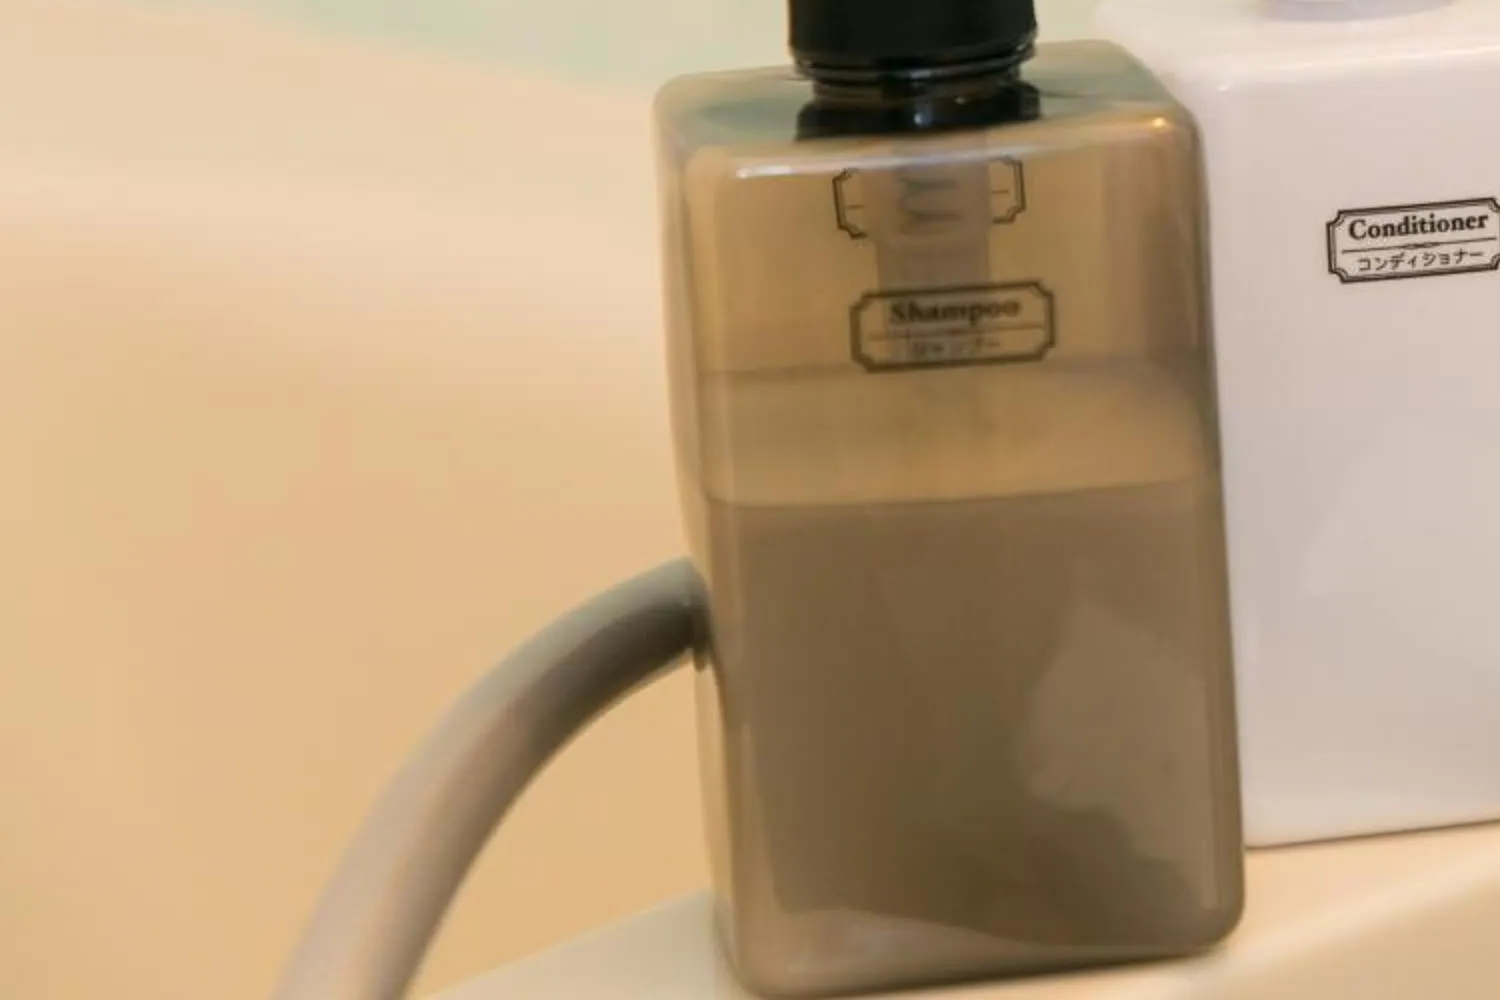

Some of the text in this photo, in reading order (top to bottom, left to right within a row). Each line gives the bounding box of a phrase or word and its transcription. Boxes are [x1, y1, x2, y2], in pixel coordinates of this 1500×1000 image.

[1348, 213, 1489, 240] Conditioner
[1358, 248, 1484, 271] コンディショナー
[889, 299, 1022, 327] Shampoo
